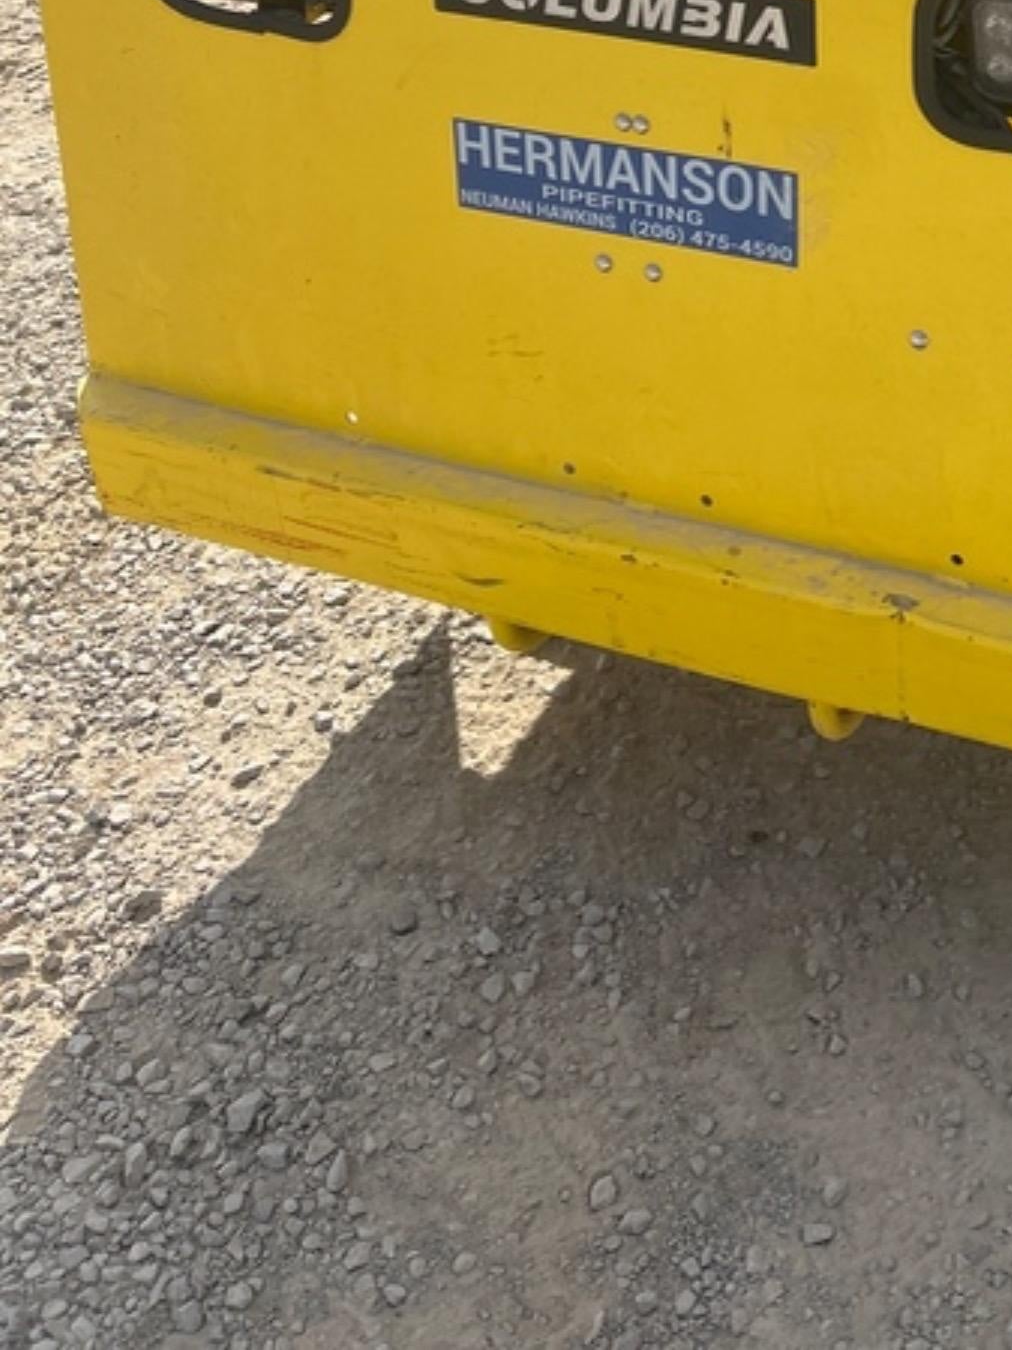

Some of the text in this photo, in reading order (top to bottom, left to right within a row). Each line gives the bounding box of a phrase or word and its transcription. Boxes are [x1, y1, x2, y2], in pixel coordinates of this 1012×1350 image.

[456, 122, 793, 220] HERMANSON
[541, 183, 704, 226] PIPEFITTING
[460, 188, 793, 263] NEUMAN HAWKINS (206) 475-4590
